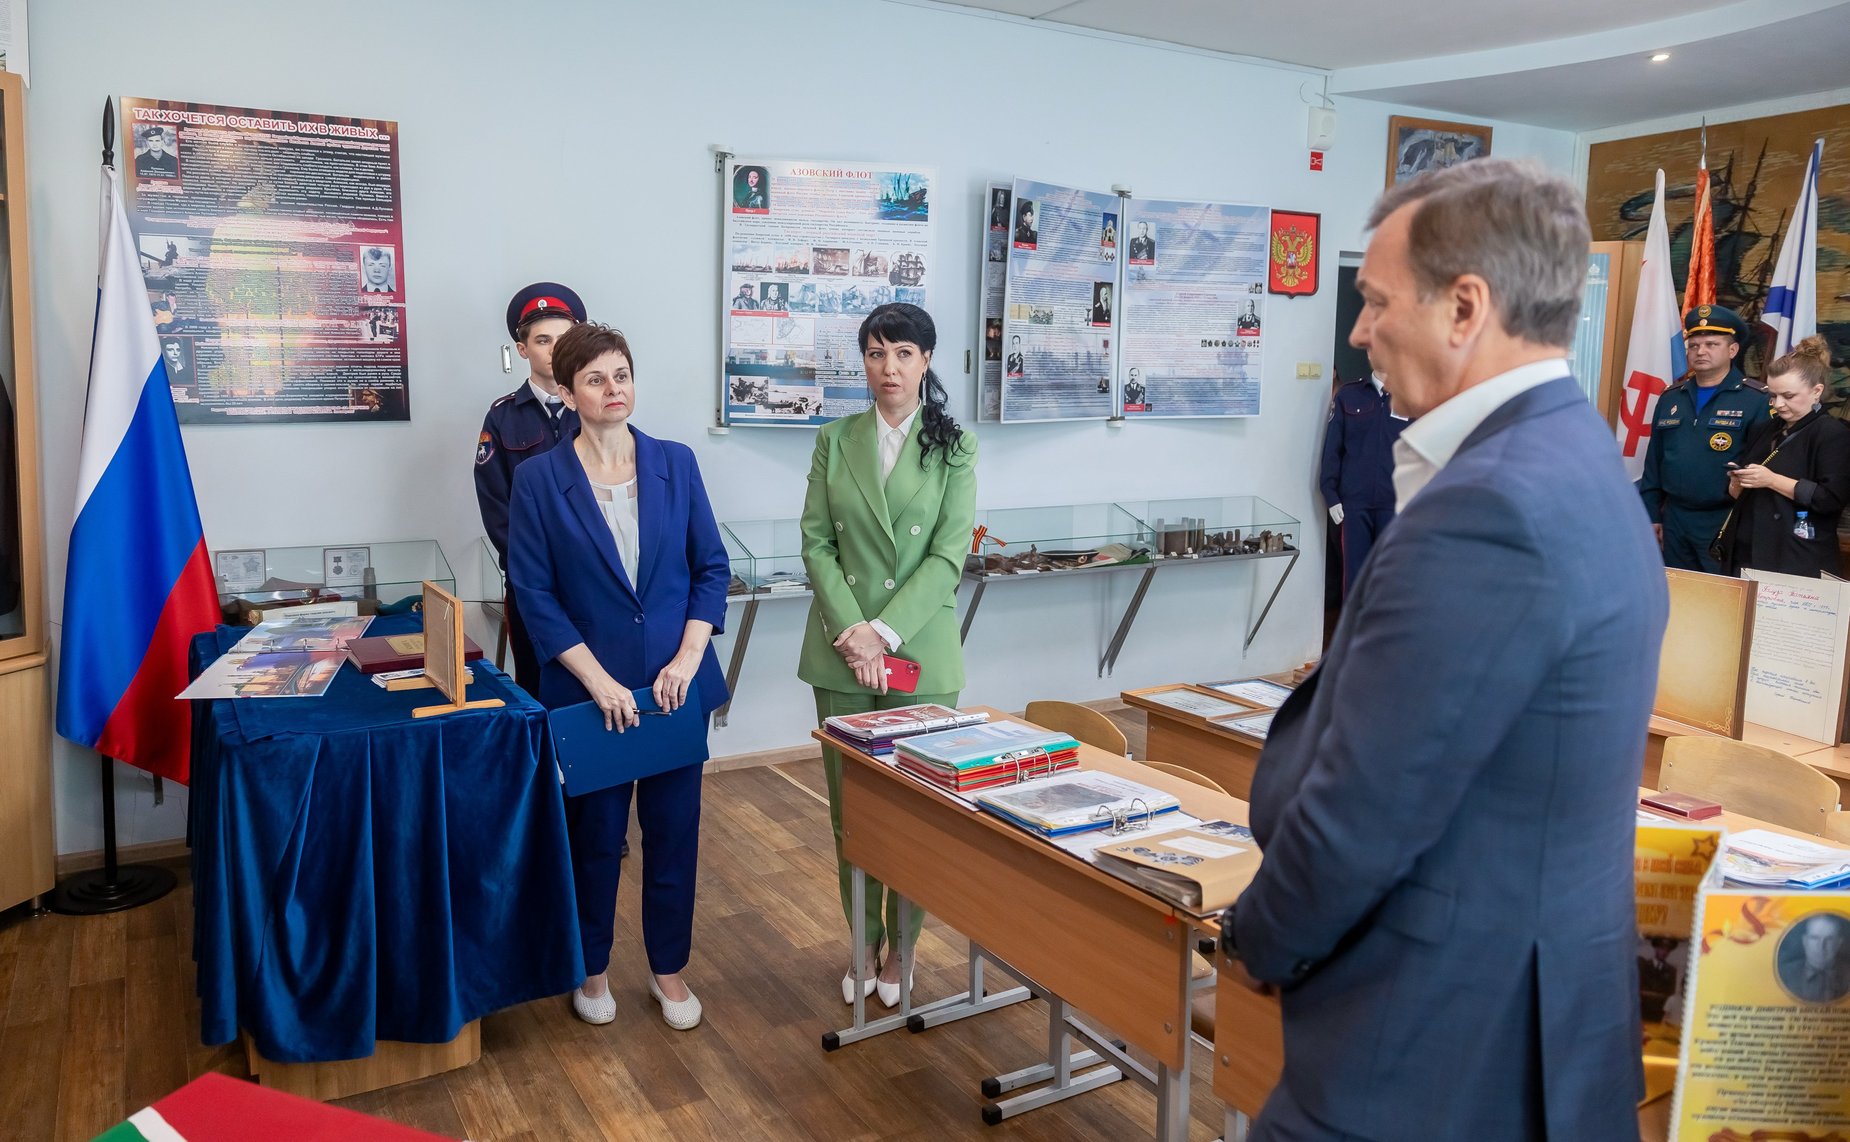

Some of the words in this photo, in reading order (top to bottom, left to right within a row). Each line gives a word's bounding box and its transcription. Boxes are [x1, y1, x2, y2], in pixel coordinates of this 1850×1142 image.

[134, 108, 160, 121] ТАК
[161, 111, 225, 126] ХОЧЕТСЯ
[228, 117, 297, 132] ОСТАВИТЬ
[299, 122, 315, 133] ИХ
[319, 124, 328, 134] В
[329, 125, 378, 139] ЖИВЫХ
[791, 168, 843, 178] АЗОВСКИЙ
[845, 171, 873, 179] ФЛОТ
